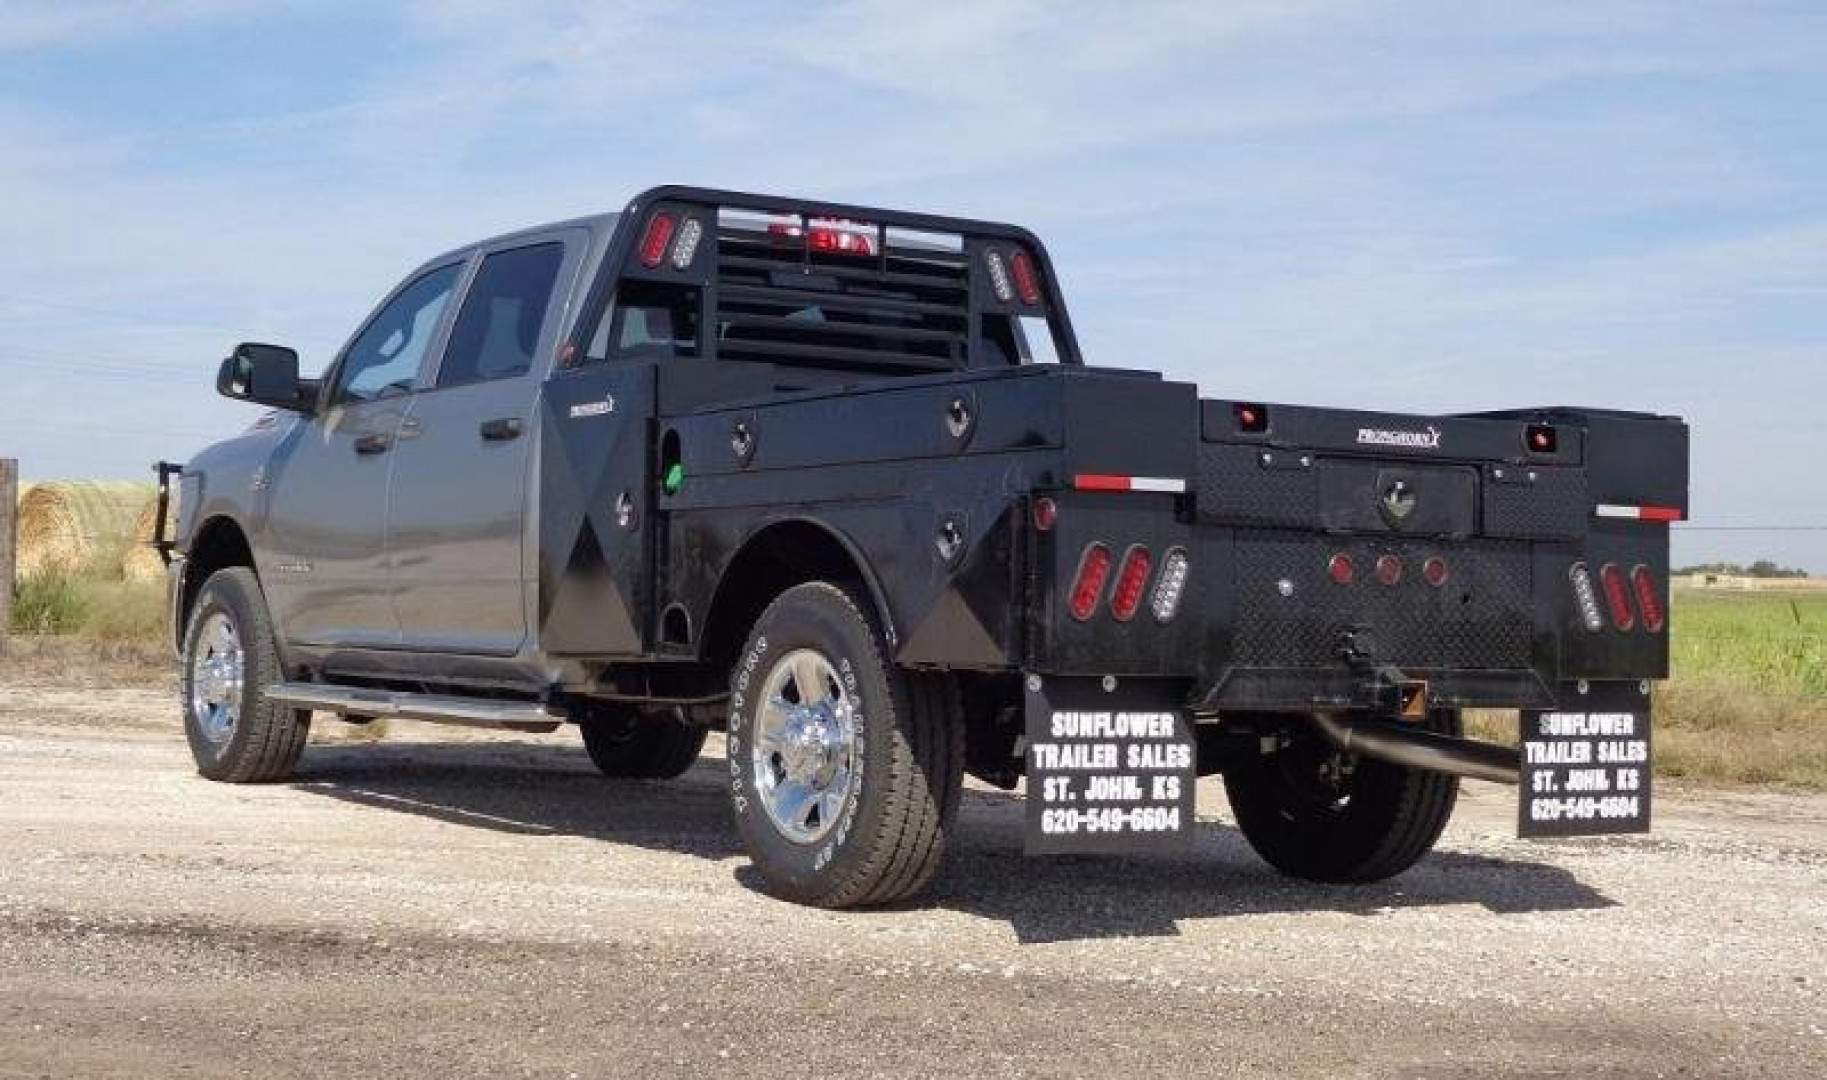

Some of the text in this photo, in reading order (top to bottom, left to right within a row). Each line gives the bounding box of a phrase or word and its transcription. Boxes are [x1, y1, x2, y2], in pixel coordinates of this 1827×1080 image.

[1052, 712, 1175, 738] SUNFLOWER
[1539, 712, 1634, 736] SUNFLOWER
[1032, 743, 1191, 768] TRAILER SALES
[1524, 740, 1648, 764] TRAILER SALES
[1043, 777, 1076, 802] ST.
[1152, 776, 1182, 800] KS
[1532, 770, 1559, 793] ST.
[1616, 769, 1640, 791] KS
[1041, 806, 1180, 834] 620-549-6604
[1531, 796, 1640, 820] 620-549-6604
